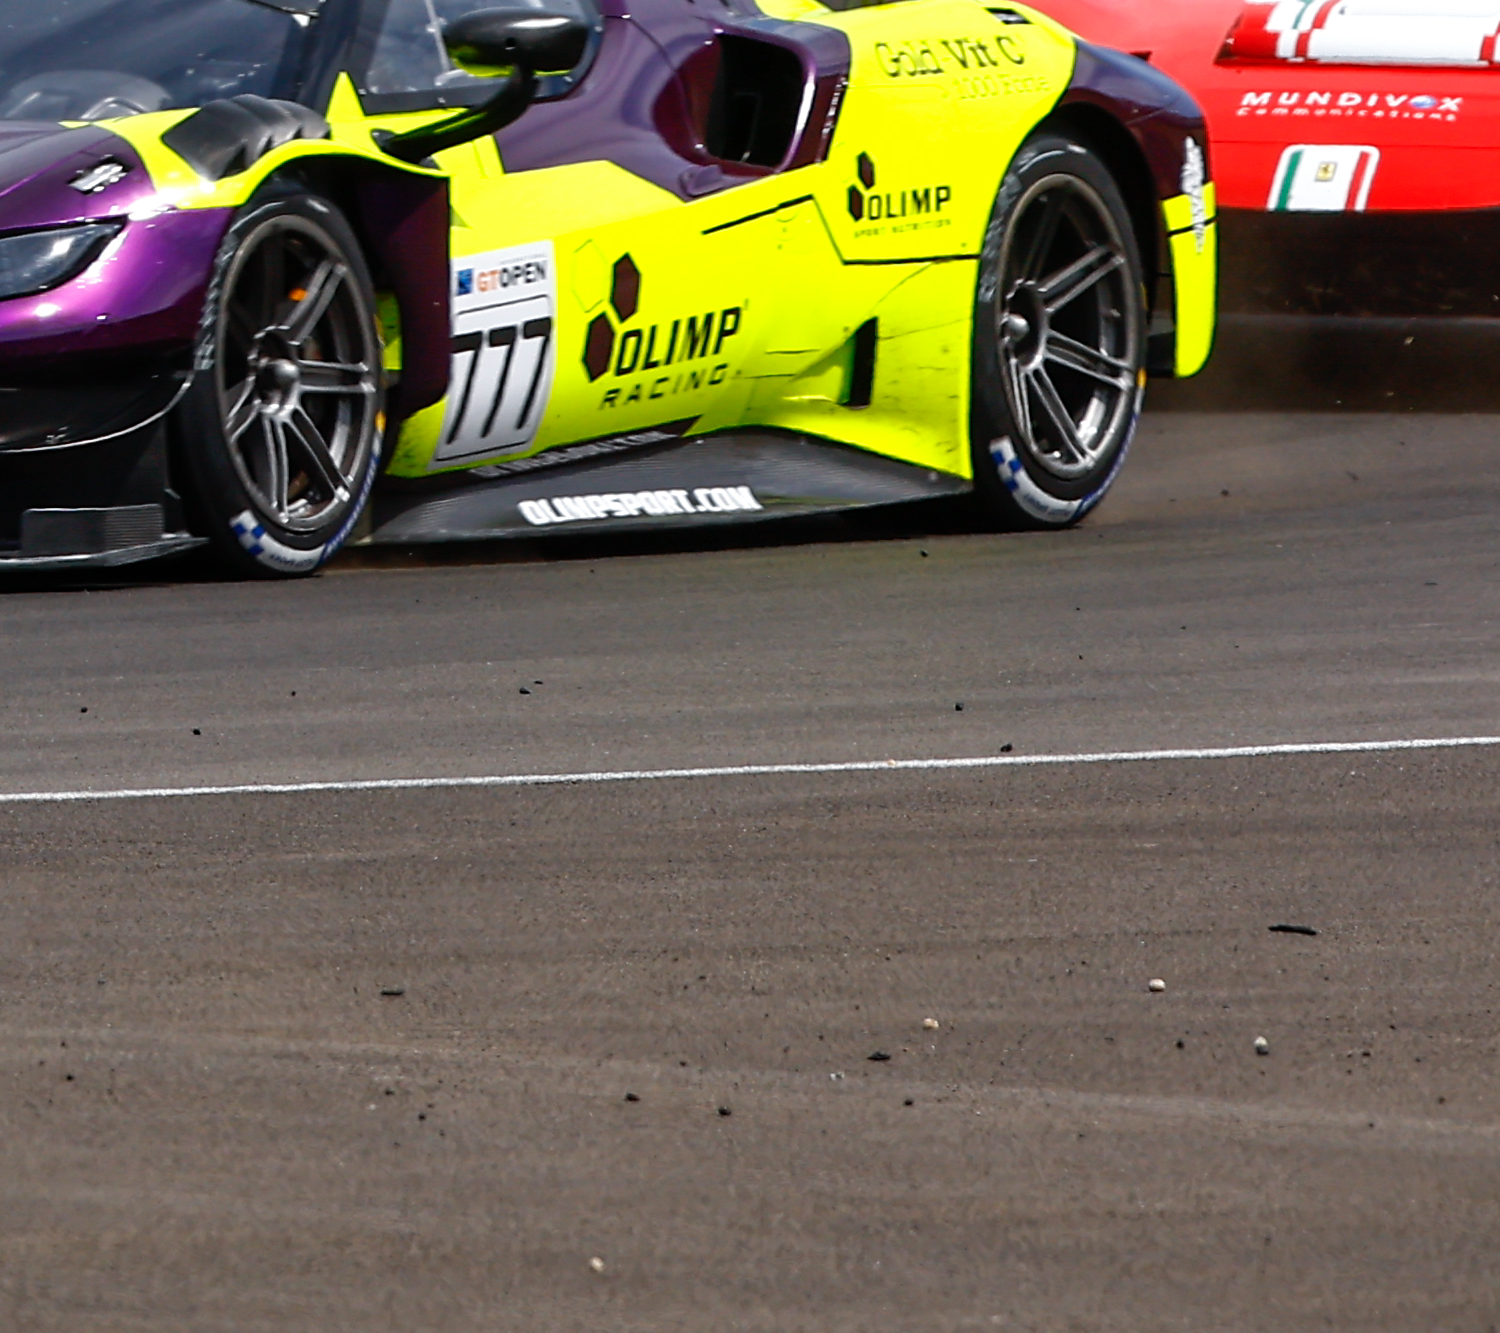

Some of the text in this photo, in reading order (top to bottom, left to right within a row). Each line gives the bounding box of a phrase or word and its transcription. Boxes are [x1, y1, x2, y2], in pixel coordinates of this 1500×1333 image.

[995, 35, 1025, 65] C
[867, 185, 951, 222] OLIMP
[614, 306, 741, 377] OLIMP
[446, 315, 553, 445] 777
[598, 363, 730, 411] RACING
[516, 485, 766, 526] OLIMPSPORT.COM
